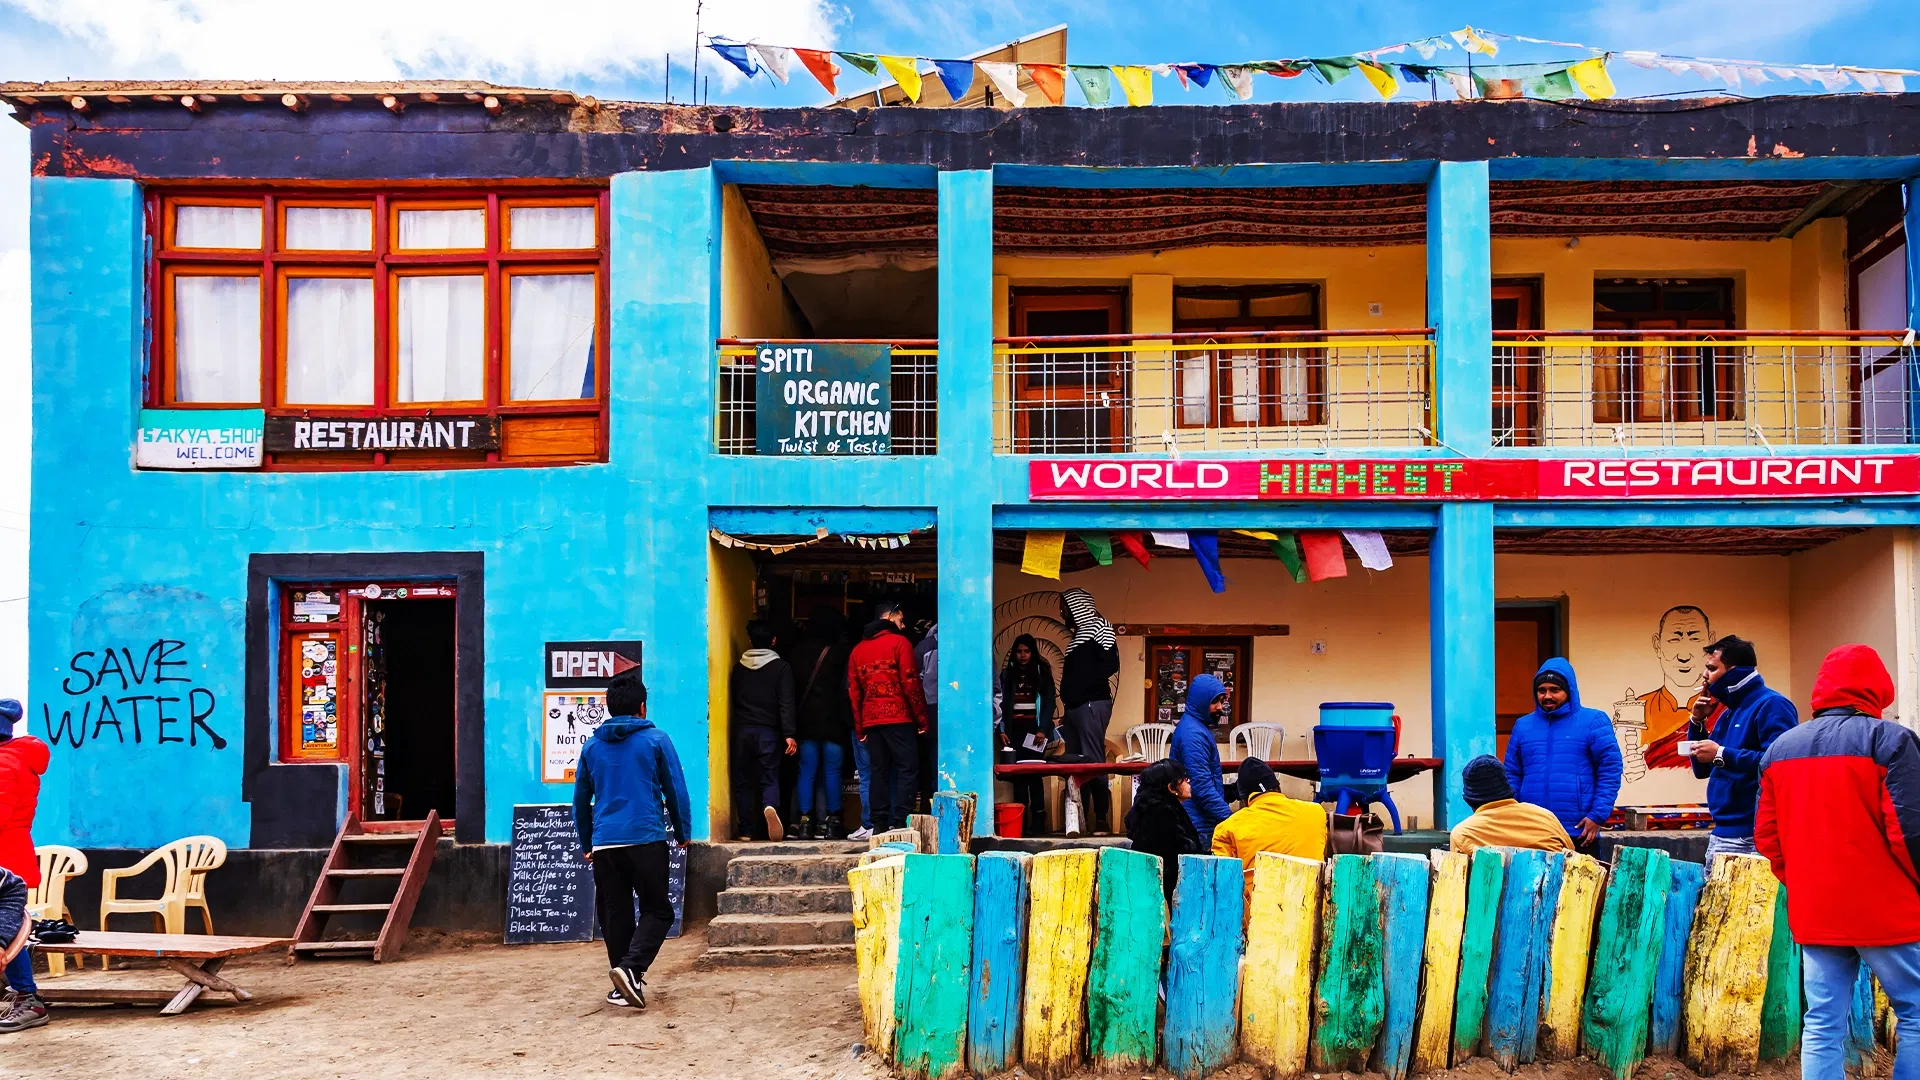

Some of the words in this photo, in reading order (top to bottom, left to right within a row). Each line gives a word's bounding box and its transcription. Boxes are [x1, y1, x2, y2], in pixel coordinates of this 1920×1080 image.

[760, 348, 812, 373] SPITI
[784, 379, 879, 405] ORGANIC
[294, 421, 475, 448] RESTAURANT
[795, 410, 891, 438] KITCHEN
[778, 437, 818, 454] Twist
[827, 440, 840, 453] of
[847, 437, 886, 454] Taste
[1050, 463, 1229, 489] WORLD
[1260, 463, 1464, 494] HIGHEST
[1564, 460, 1894, 486] RESTAURANT
[63, 639, 192, 695] SAVE
[551, 651, 615, 677] OPEN
[44, 688, 227, 751] WATER
[515, 842, 542, 851] Lemon
[513, 883, 529, 891] Cold
[532, 883, 557, 894] Coffee
[567, 883, 577, 891] 60
[532, 870, 556, 884] Coffee
[565, 871, 575, 879] 60
[513, 893, 535, 903] Mint
[562, 895, 574, 904] 30
[511, 906, 541, 918] Masala
[510, 921, 537, 933] Black
